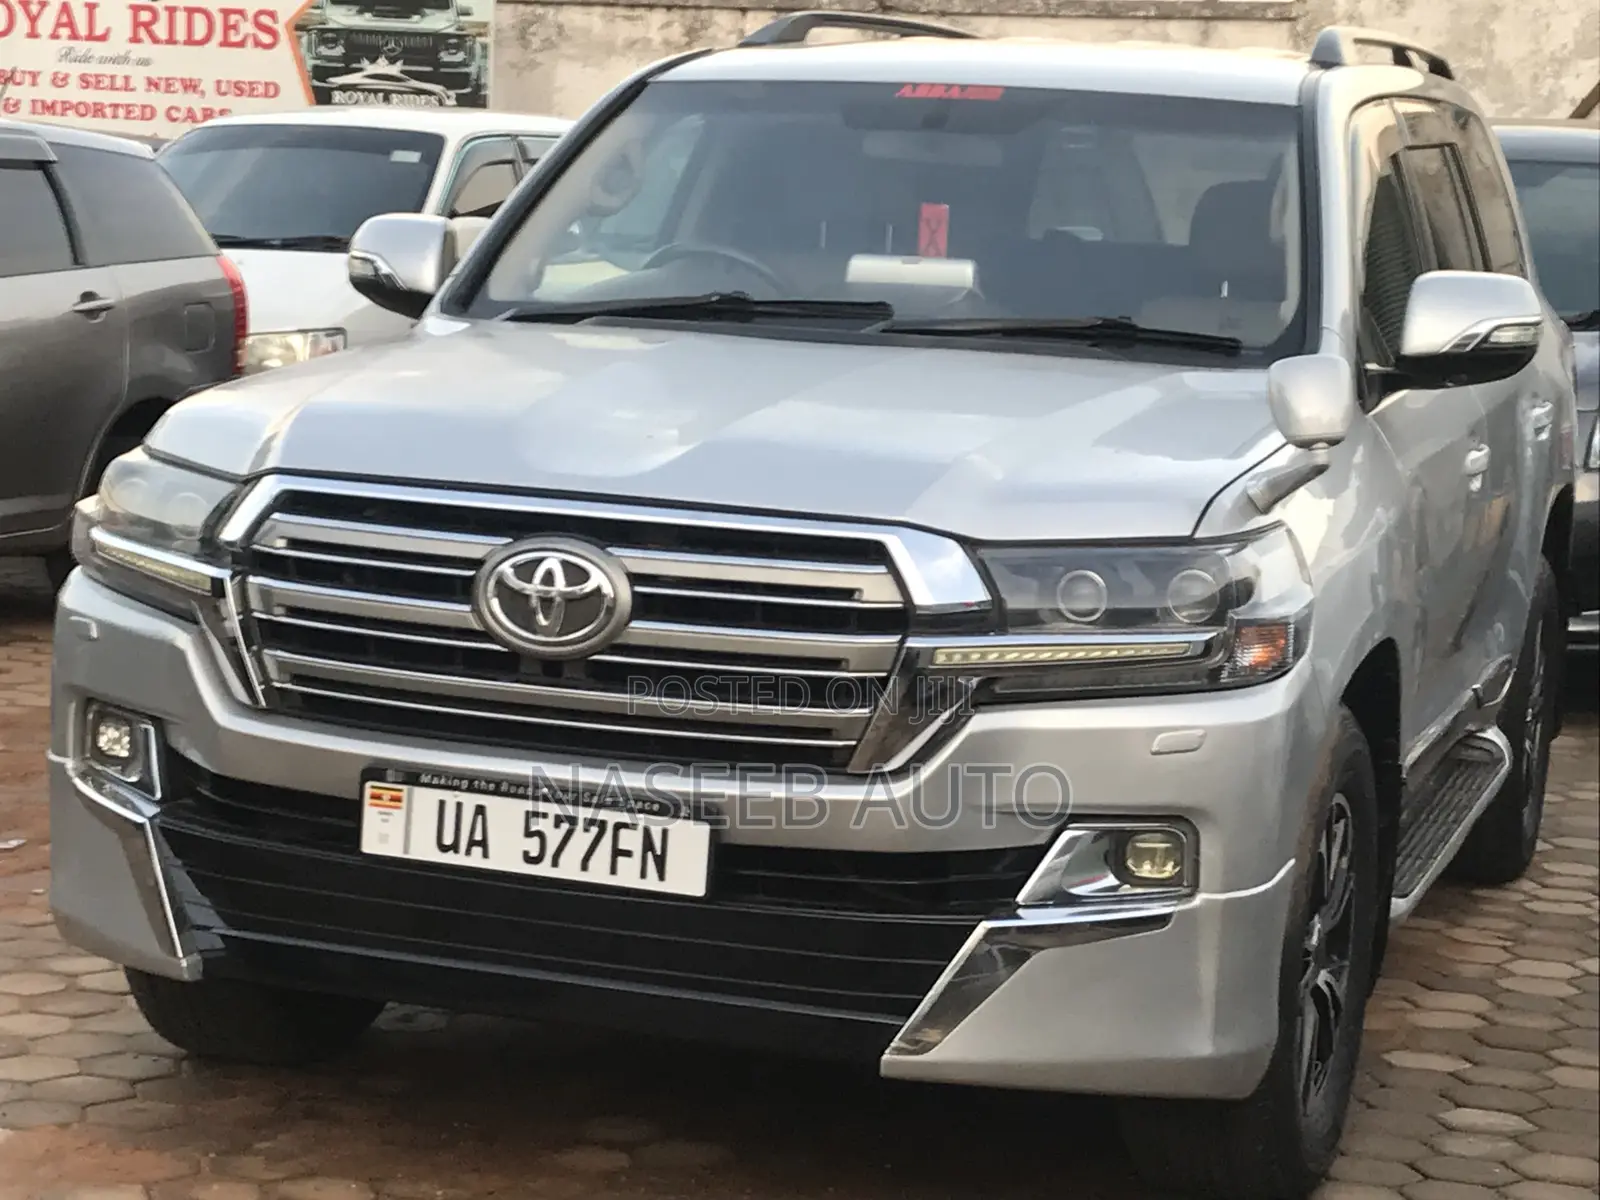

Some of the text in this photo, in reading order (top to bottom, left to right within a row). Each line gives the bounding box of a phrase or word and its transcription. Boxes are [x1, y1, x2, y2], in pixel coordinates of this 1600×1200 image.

[127, 3, 280, 49] RIDES
[57, 46, 94, 65] Ride
[96, 49, 132, 67] with
[51, 71, 70, 88] &
[79, 73, 136, 92] SELL
[144, 76, 206, 98] NEW,
[214, 79, 281, 98] USED
[3, 97, 21, 114] &
[30, 99, 158, 121] IMPORTED
[331, 90, 440, 107] ROYAL RIDES
[435, 798, 669, 882] UA 577FN
